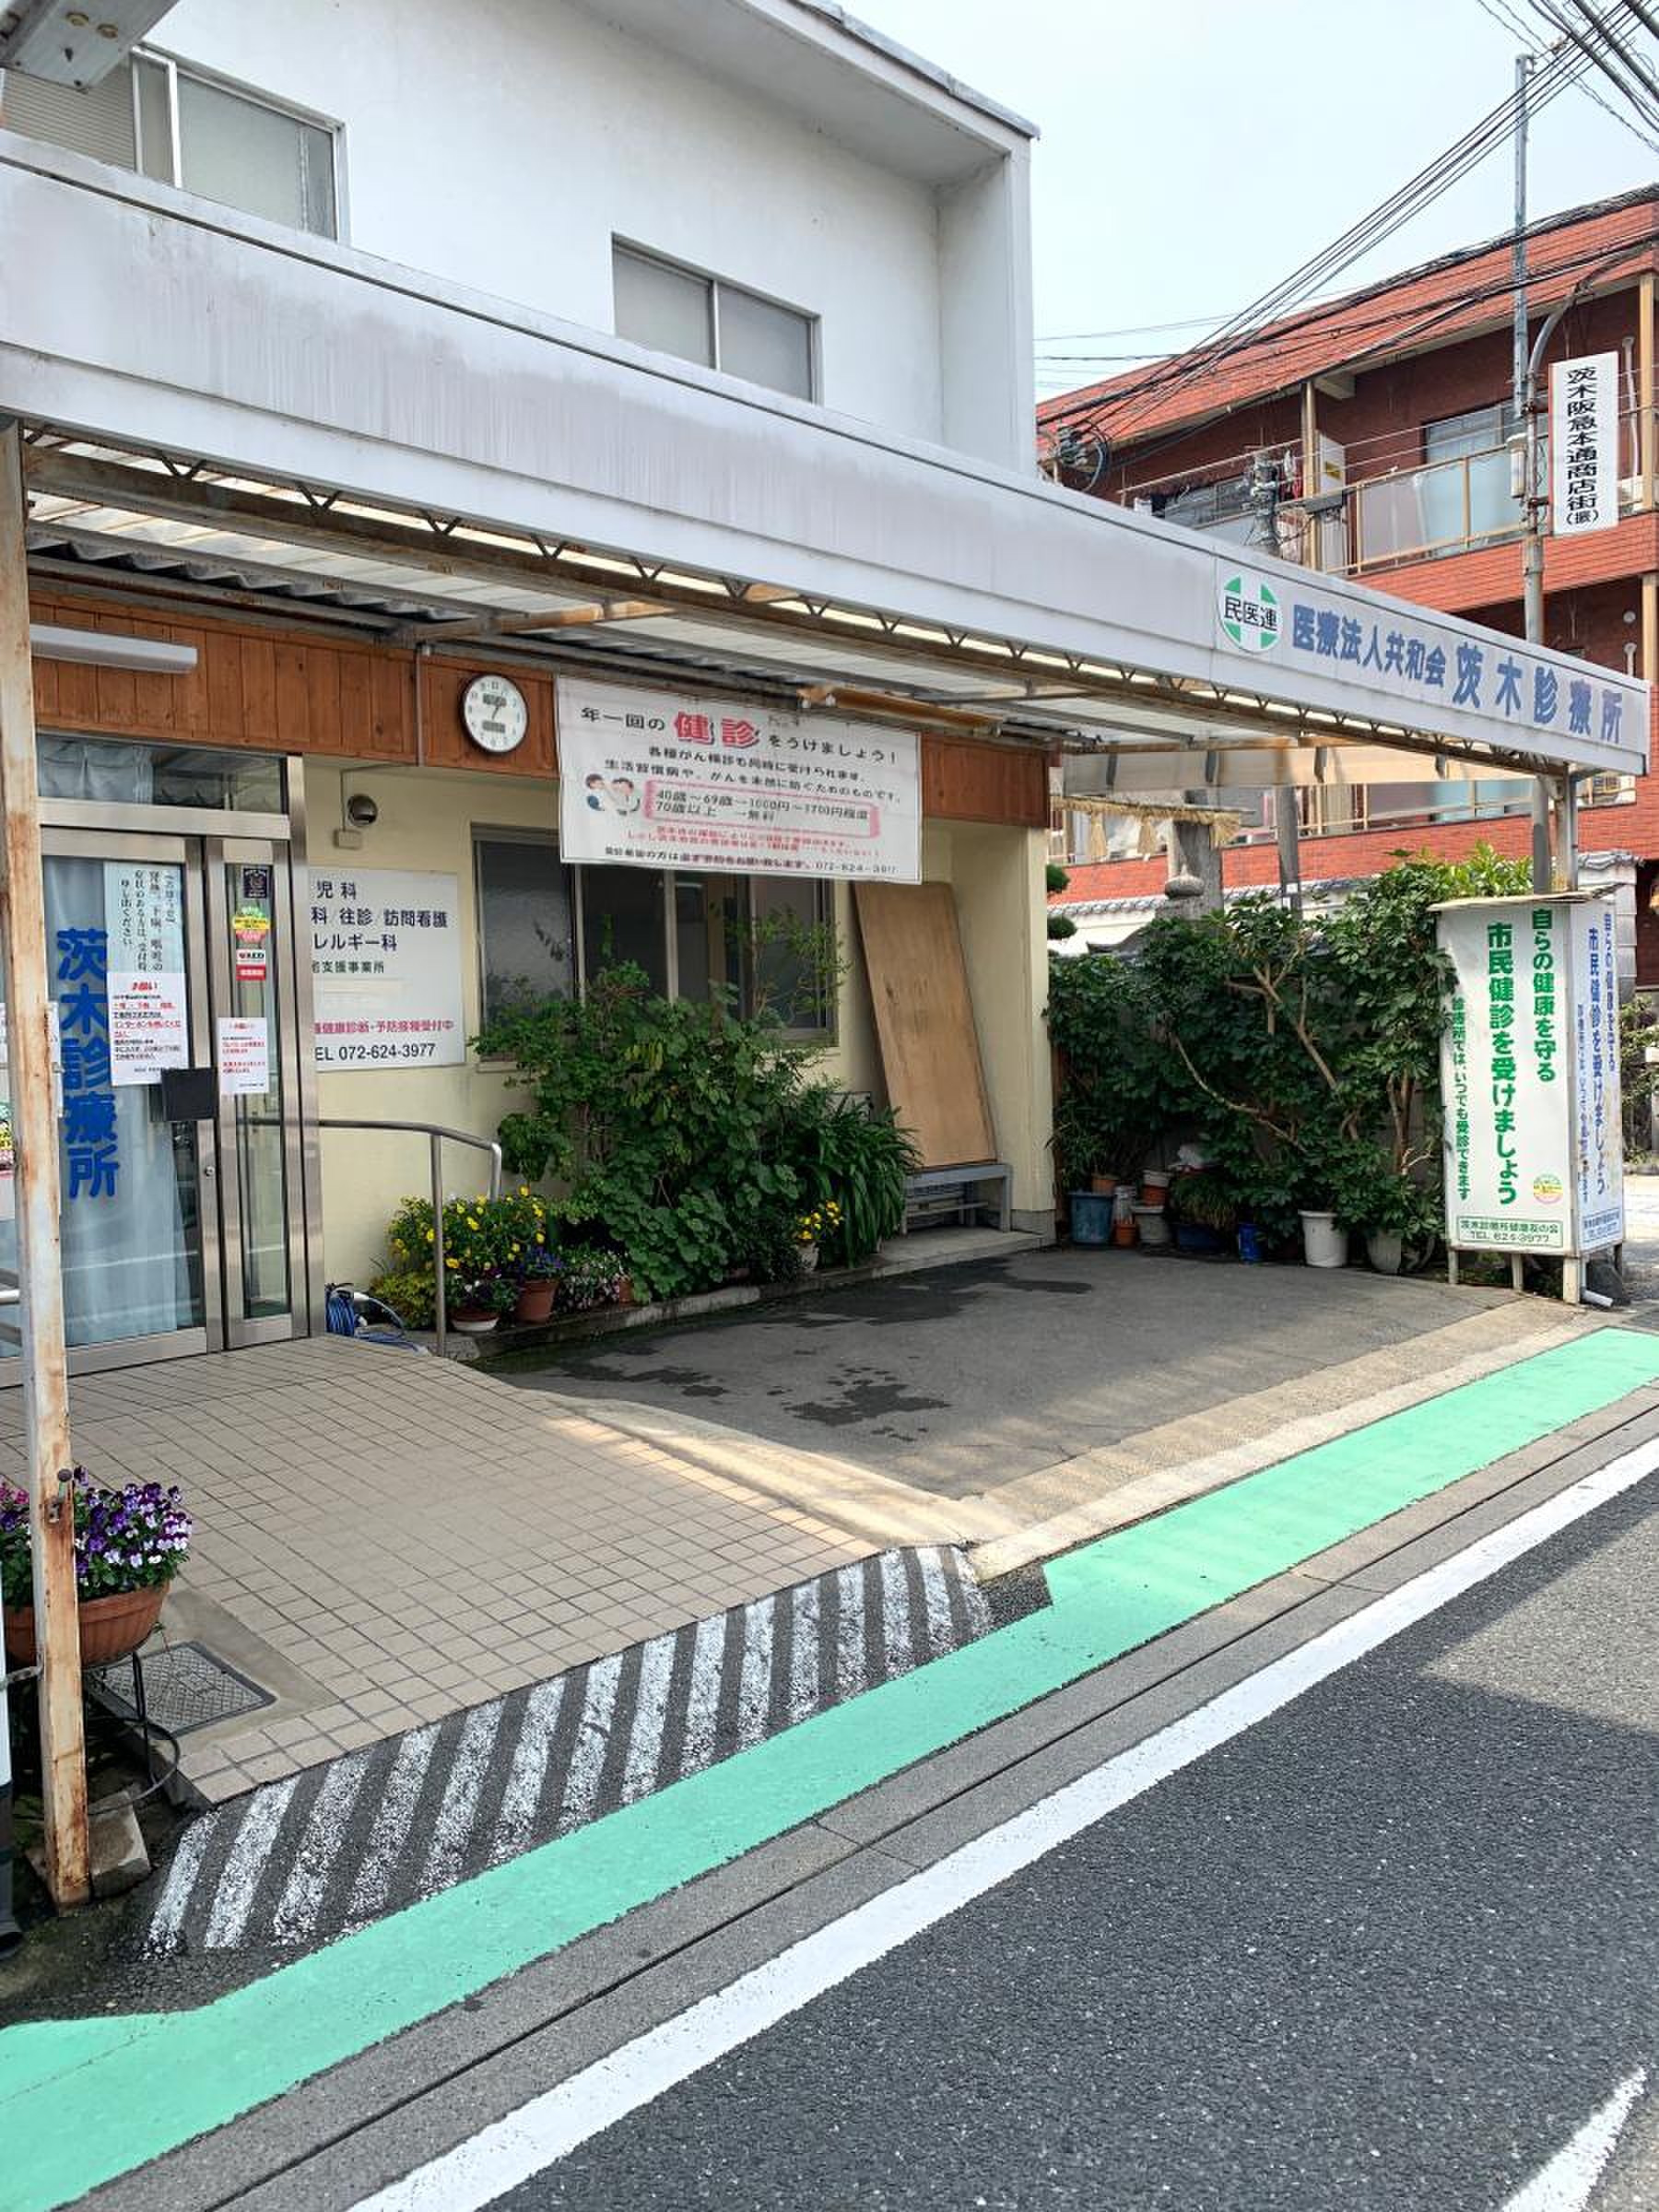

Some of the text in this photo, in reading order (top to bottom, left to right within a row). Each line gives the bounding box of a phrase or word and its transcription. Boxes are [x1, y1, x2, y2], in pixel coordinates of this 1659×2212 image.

[1224, 594, 1278, 632] 民医連
[1292, 604, 1623, 745] 医療法人共和会 茨木診療所
[313, 933, 398, 952] レルギー科
[339, 907, 373, 926] 往診
[382, 909, 449, 928] 訪問看護
[1532, 908, 1557, 1083] 自らの健康を守る
[57, 927, 119, 1198] 茨木診療所
[338, 1042, 437, 1061] 072-624-3977
[1487, 922, 1519, 1206] 市民健診を受けましょう
